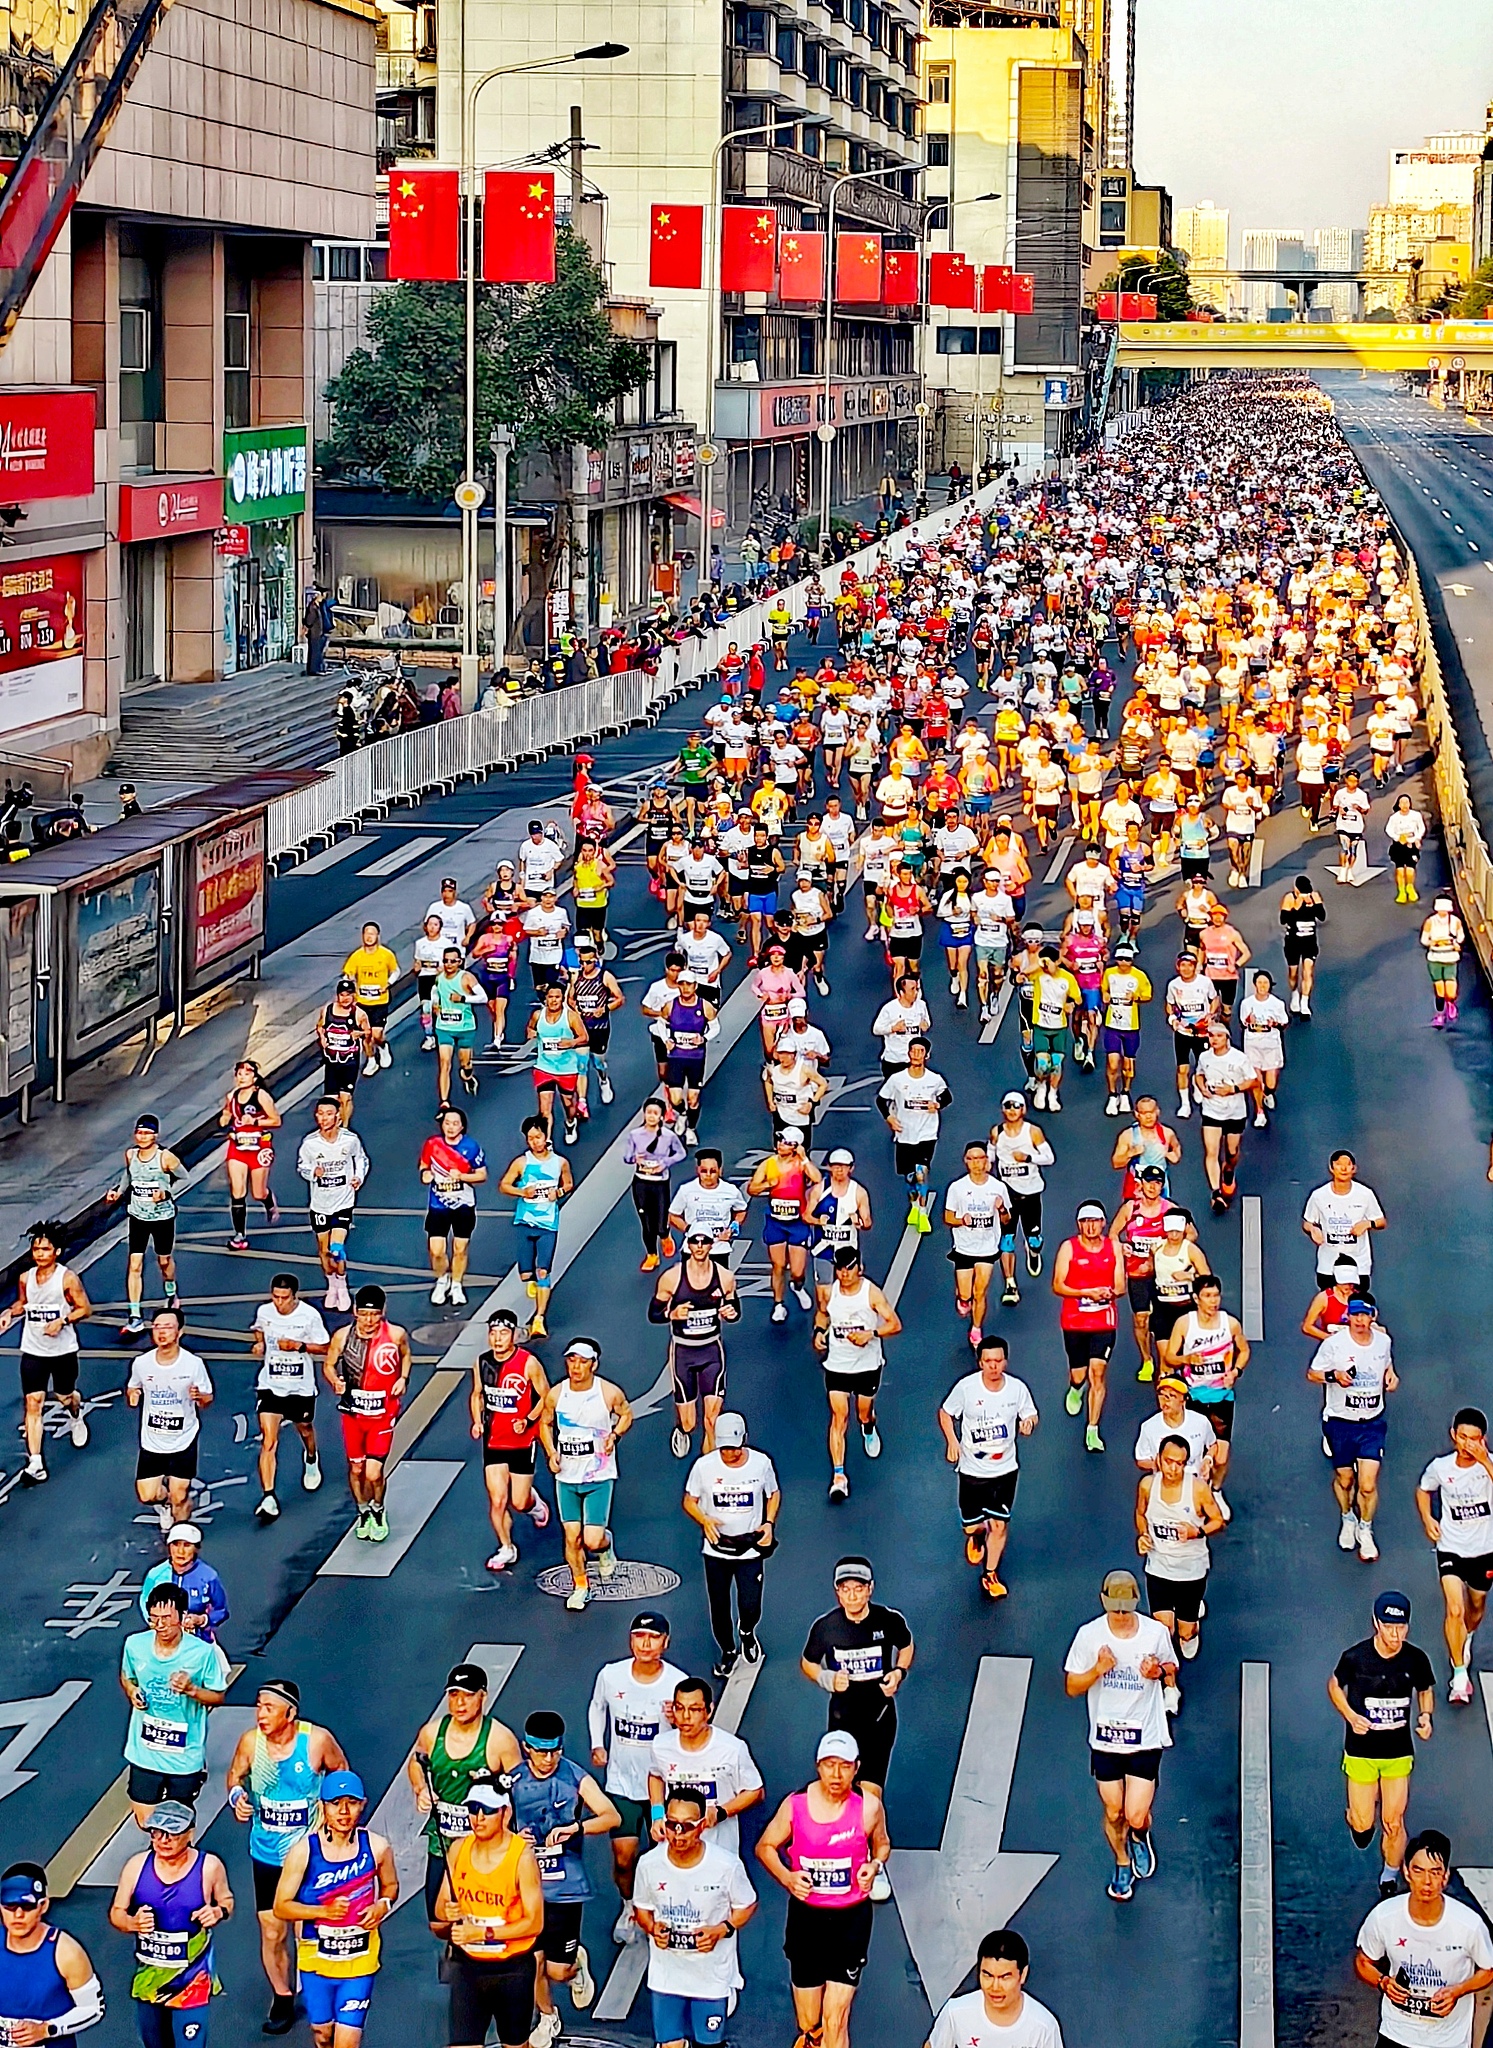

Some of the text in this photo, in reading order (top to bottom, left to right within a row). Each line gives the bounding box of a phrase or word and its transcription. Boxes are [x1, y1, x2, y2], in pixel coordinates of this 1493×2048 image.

[246, 446, 306, 500] 峰力助听器
[315, 1213, 327, 1226] 10
[812, 1871, 846, 1884] 42793
[458, 1886, 505, 1907] PACER
